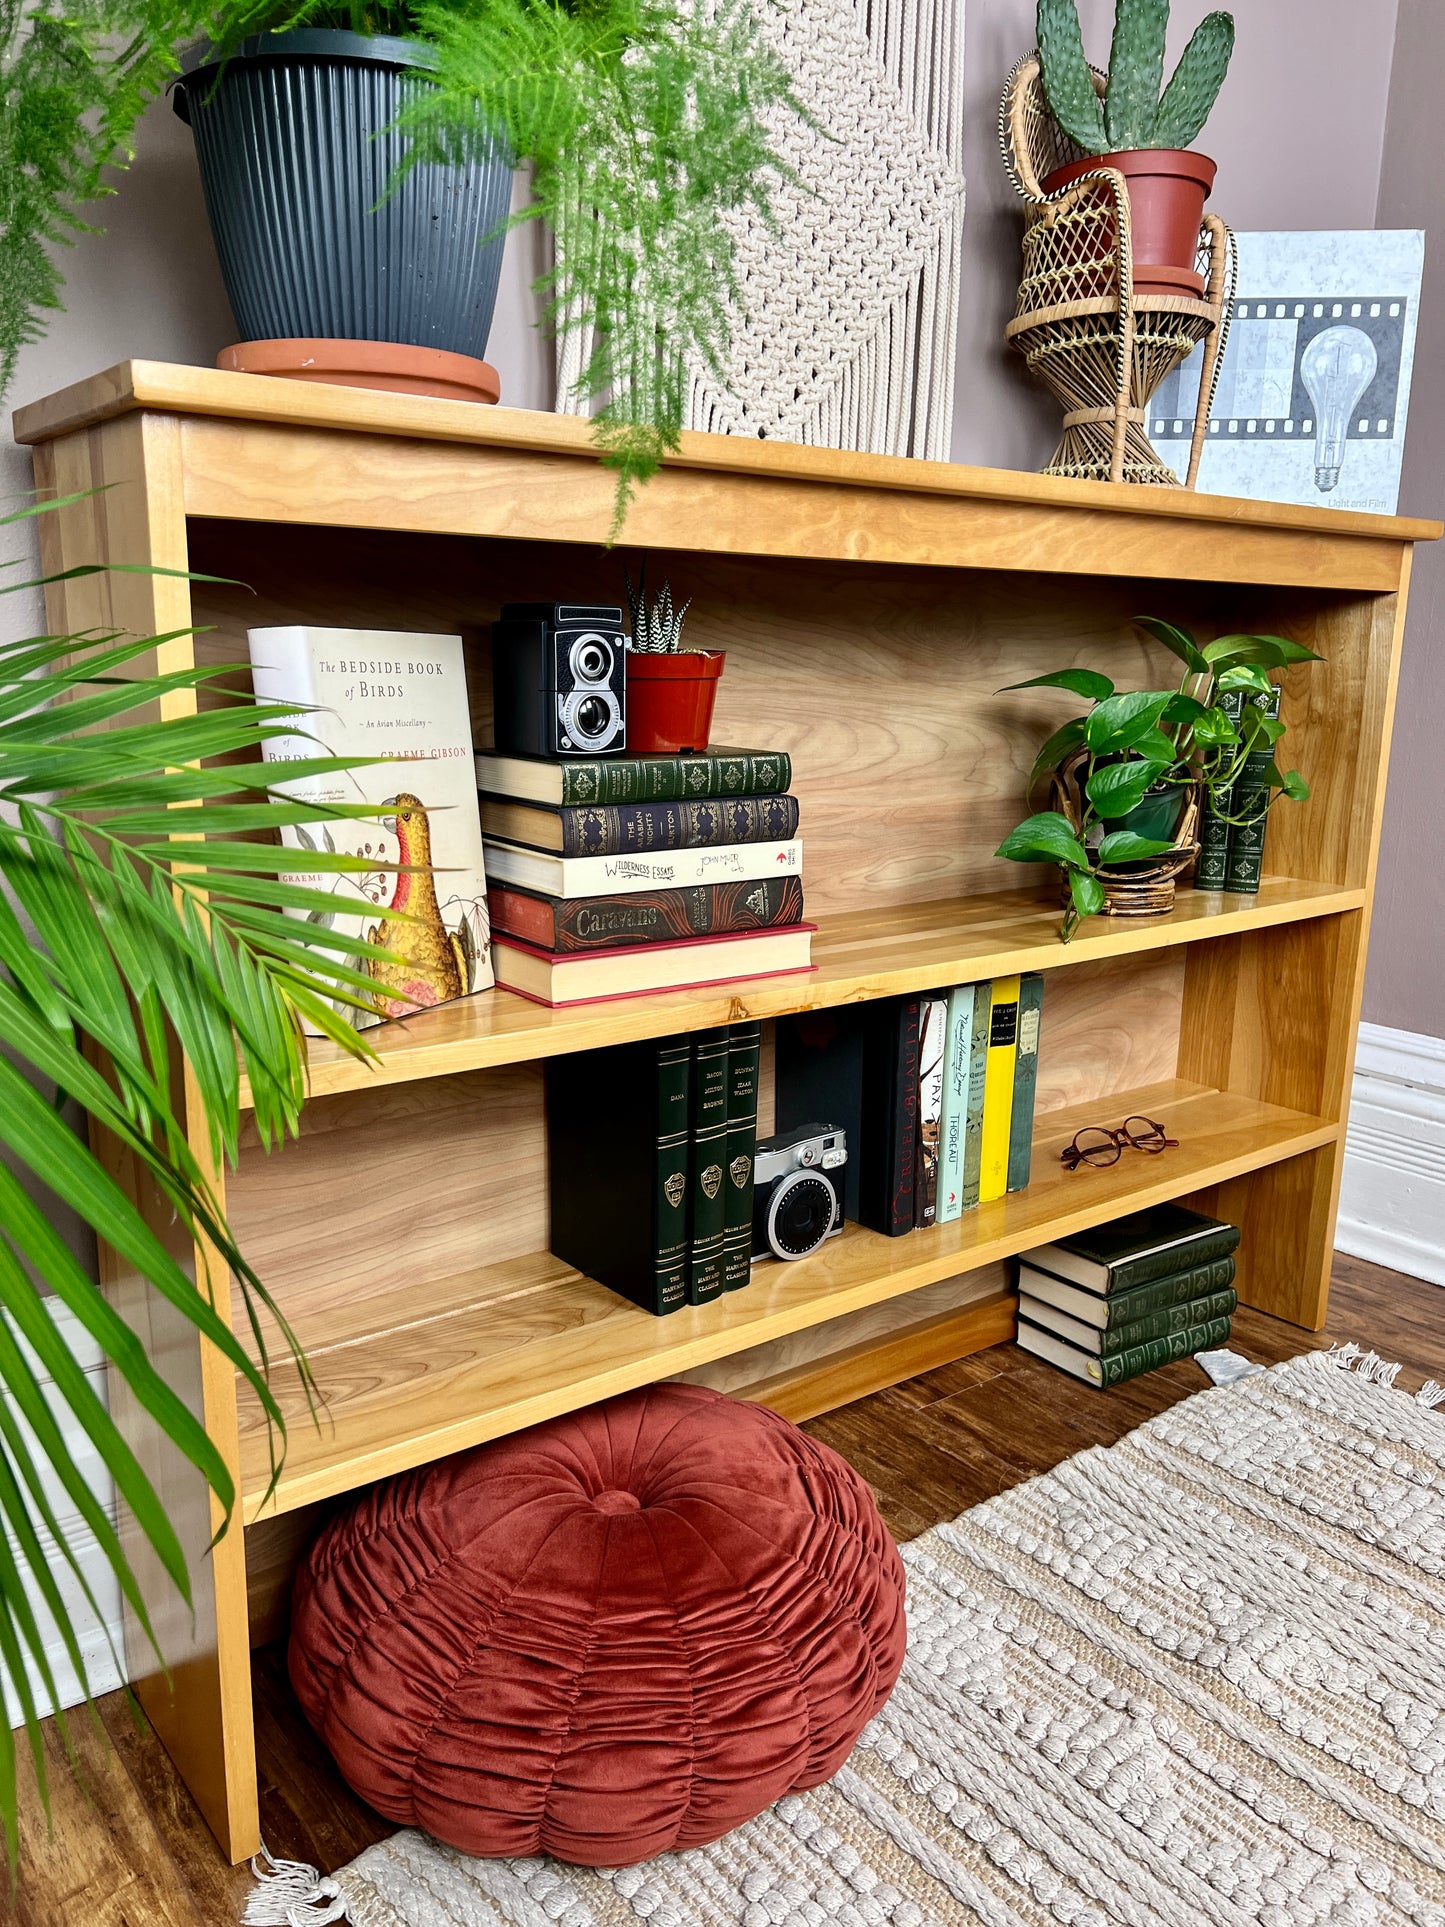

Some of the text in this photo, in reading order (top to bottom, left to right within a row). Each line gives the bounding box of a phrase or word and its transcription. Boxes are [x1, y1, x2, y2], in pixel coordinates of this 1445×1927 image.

[1328, 499, 1387, 508] Light and Film
[320, 661, 443, 675] The BEDSIDE BOOK
[345, 681, 404, 700] of BIRDS
[366, 718, 426, 729] An Avian Miscellany
[282, 738, 290, 747] of
[430, 747, 467, 759] GIBSON
[627, 821, 635, 841] THE
[636, 811, 644, 849] ARABIAN
[646, 812, 654, 846] NIGHTS
[667, 810, 675, 845] BURTON
[605, 860, 650, 877] WILDERNESS
[652, 865, 675, 880] ESSAYS
[696, 855, 719, 876] JOHN
[282, 874, 324, 883] GRAEME
[576, 907, 657, 936] Caravans
[903, 1022, 917, 1112] BEAUTY
[706, 1071, 723, 1079] BACON
[931, 1073, 942, 1107] PAX
[670, 1093, 685, 1101] DANA
[703, 1099, 724, 1109] BROWNE
[949, 1115, 959, 1163] THOREAU
[704, 1264, 716, 1272] THE
[725, 1261, 749, 1272] HARVARD
[669, 1274, 680, 1283] THE
[697, 1272, 720, 1284] HARVARD
[726, 1270, 748, 1281] CLASSICS
[662, 1282, 685, 1294] HARVARD
[698, 1280, 720, 1292] CLASSICS
[663, 1291, 685, 1303] CLASSICS
